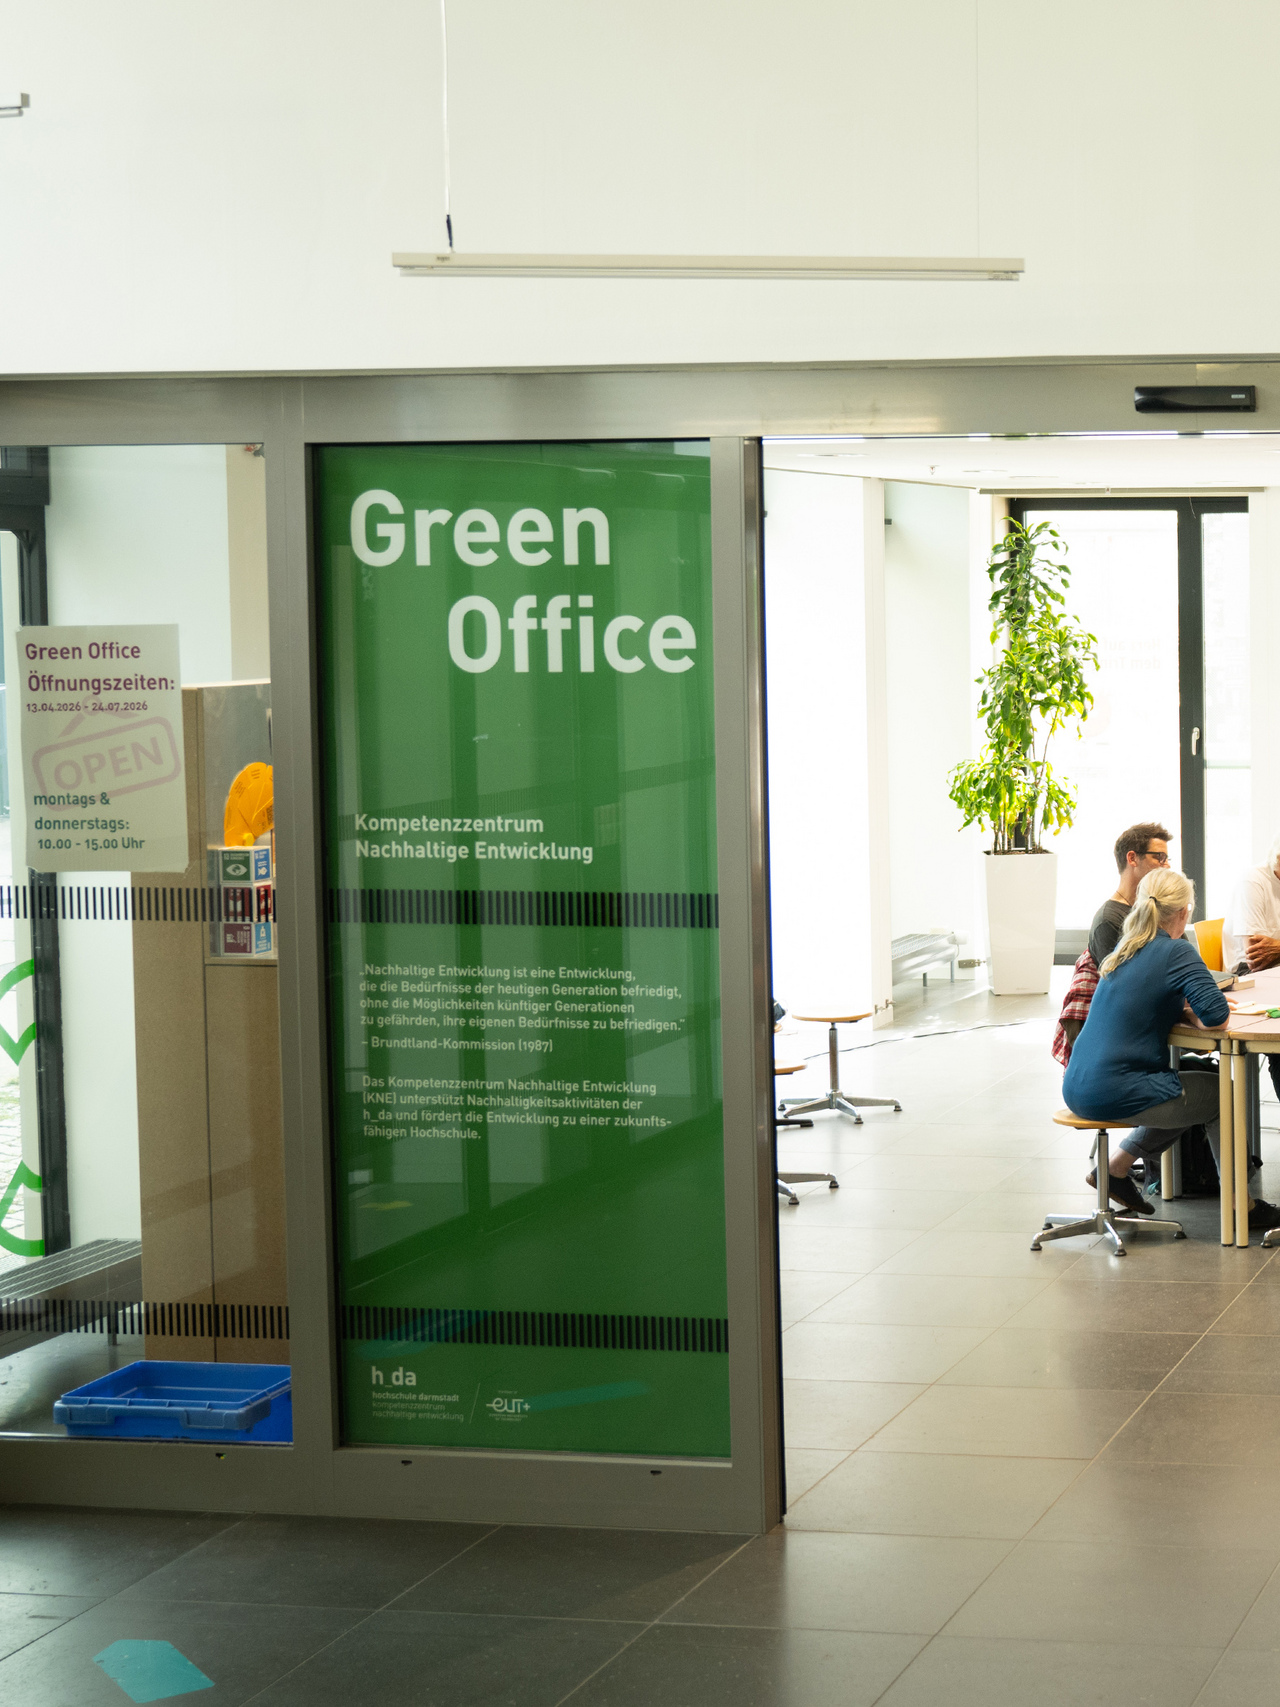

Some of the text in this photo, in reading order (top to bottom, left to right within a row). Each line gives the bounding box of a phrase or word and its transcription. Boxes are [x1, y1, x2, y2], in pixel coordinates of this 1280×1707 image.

[350, 489, 611, 567] Green
[447, 595, 697, 674] Office
[25, 641, 141, 661] Green Office
[27, 670, 176, 695] Öffnungszeiten:
[26, 702, 82, 713] 13.04.2026
[91, 701, 148, 712] 24.07.2026
[55, 737, 164, 790] OPEN
[33, 792, 110, 809] montags &
[34, 816, 130, 834] donnerstags:
[355, 813, 544, 835] Kompetenzzentrum
[37, 838, 72, 850] 10.00
[84, 838, 119, 850] 15.00
[122, 836, 146, 849] Uhr
[355, 840, 594, 864] Nachhaltige Entwicklung
[360, 964, 636, 981] „Nachhaltige Entwicklung ist eine Entwicklung,
[359, 981, 681, 1000] die die Bedürfnisse der heutigen Generation befriedigt,
[359, 997, 635, 1014] ohne die Möglichkeiten künftiger Generationen
[361, 1016, 375, 1026] zu
[377, 1014, 440, 1029] gefährden,
[443, 1015, 466, 1027] ihre
[468, 1016, 515, 1030] eigenen
[518, 1016, 590, 1030] Bedürfnisse
[593, 1019, 607, 1030] zu
[371, 1036, 515, 1051] Brundtland-Kommission
[518, 1039, 553, 1052] (1987)
[362, 1076, 657, 1096] Das Kompetenzzentrum Nachhaltige Entwicklung
[363, 1092, 643, 1110] (KNE) unterstützt Nachhaltigkeitsaktivitäten der
[363, 1109, 672, 1128] h_da und fördert die Entwicklung zu einer zukunfts-
[363, 1125, 481, 1140] fähigen Hochschule.
[372, 1366, 417, 1388] h_da
[372, 1391, 459, 1402] hochschule darmstadt
[372, 1401, 445, 1411] kompetenzzentrum
[372, 1410, 464, 1422] nachhaltige entwicklung
